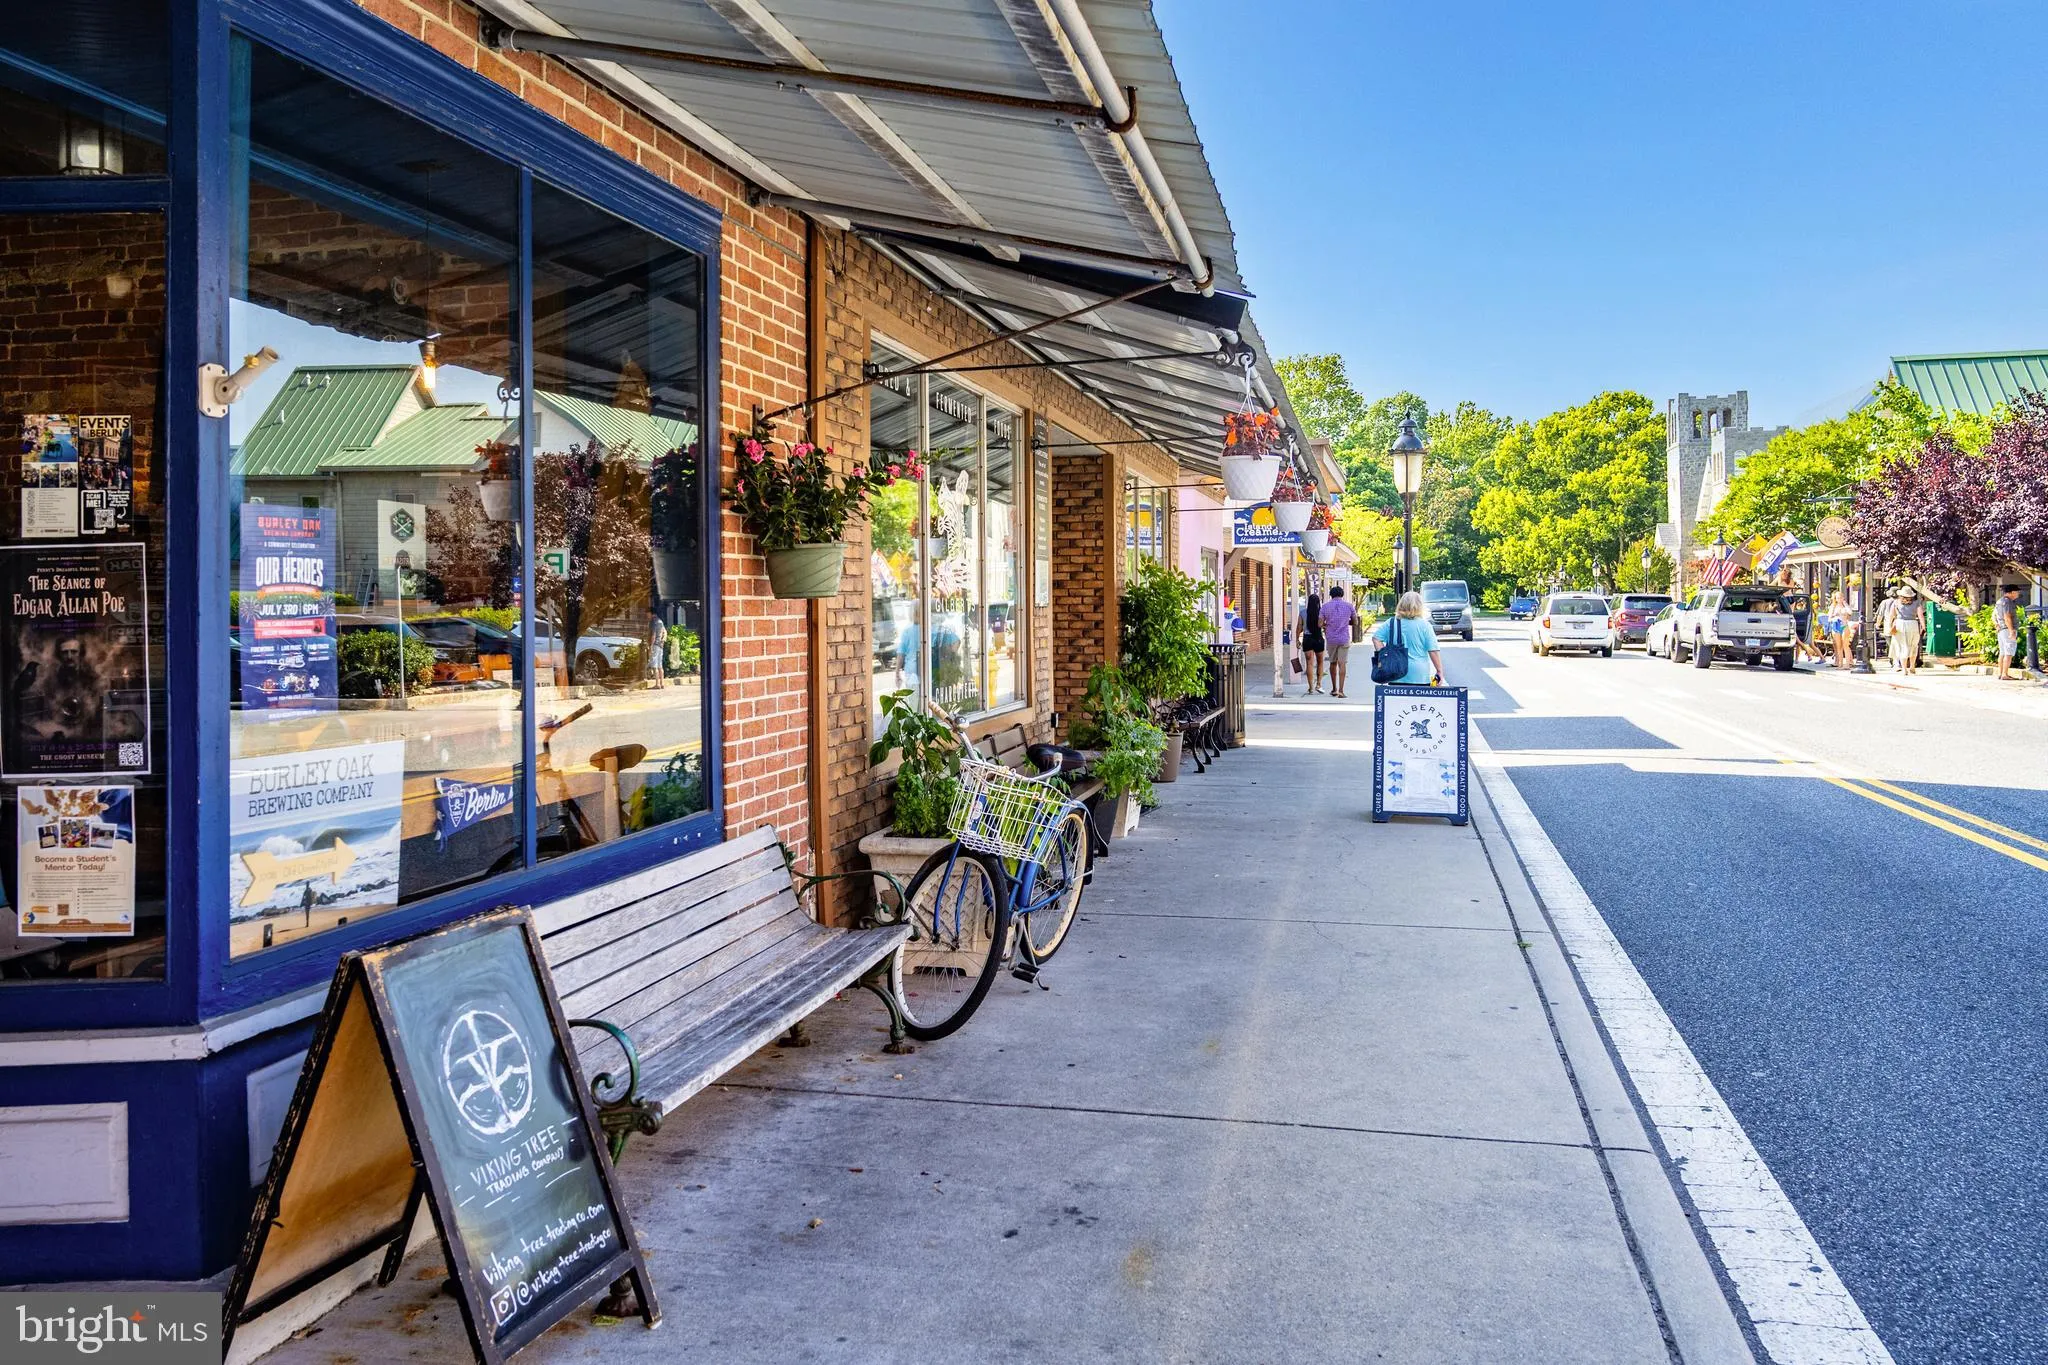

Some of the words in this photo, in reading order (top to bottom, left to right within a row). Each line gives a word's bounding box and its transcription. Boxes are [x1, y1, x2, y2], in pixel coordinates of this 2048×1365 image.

[935, 392, 972, 423] FERMENTED
[80, 417, 130, 429] EVENTS
[89, 429, 122, 438] BERLIN
[86, 500, 101, 508] ME!
[258, 516, 298, 529] BURLEY
[302, 519, 320, 531] OAK
[256, 556, 280, 588] OUR
[282, 556, 324, 588] HEROES
[28, 575, 50, 593] THE
[94, 577, 107, 590] OF
[13, 593, 54, 618] EDGAR
[57, 591, 98, 617] ALLAN
[102, 591, 126, 617] POE
[260, 603, 282, 616] JULY
[282, 603, 298, 616] 3RD
[302, 603, 319, 615] 6PM
[249, 760, 331, 795] BURLEY
[337, 754, 374, 782] OAK
[248, 791, 312, 818] BREWING
[316, 782, 374, 806] COMPANY
[465, 786, 507, 821] Berlin
[34, 855, 67, 863] Become
[75, 854, 117, 862] Student's
[44, 863, 76, 871] Mentor
[77, 863, 106, 872] Today!
[470, 1148, 522, 1186] VIKING
[520, 1125, 560, 1158] TREE
[485, 1166, 530, 1194] TRADING
[520, 1238, 548, 1254] tree
